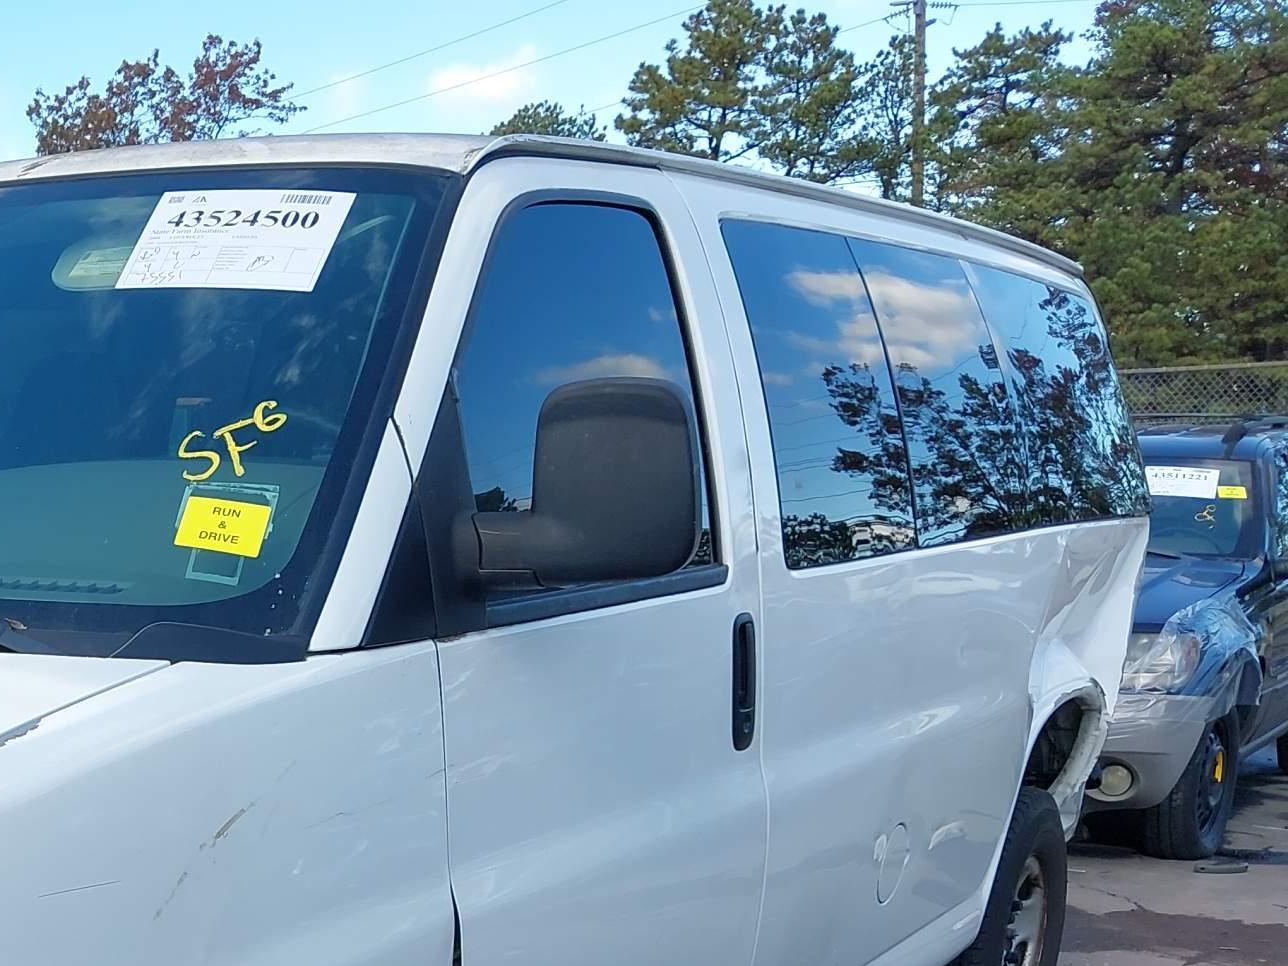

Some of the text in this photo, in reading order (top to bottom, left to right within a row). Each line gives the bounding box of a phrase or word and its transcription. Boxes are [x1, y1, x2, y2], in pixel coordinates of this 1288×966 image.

[167, 209, 320, 229] 43524500
[212, 506, 242, 518] RUN
[218, 521, 227, 529] &
[198, 530, 240, 544] DRIVE
